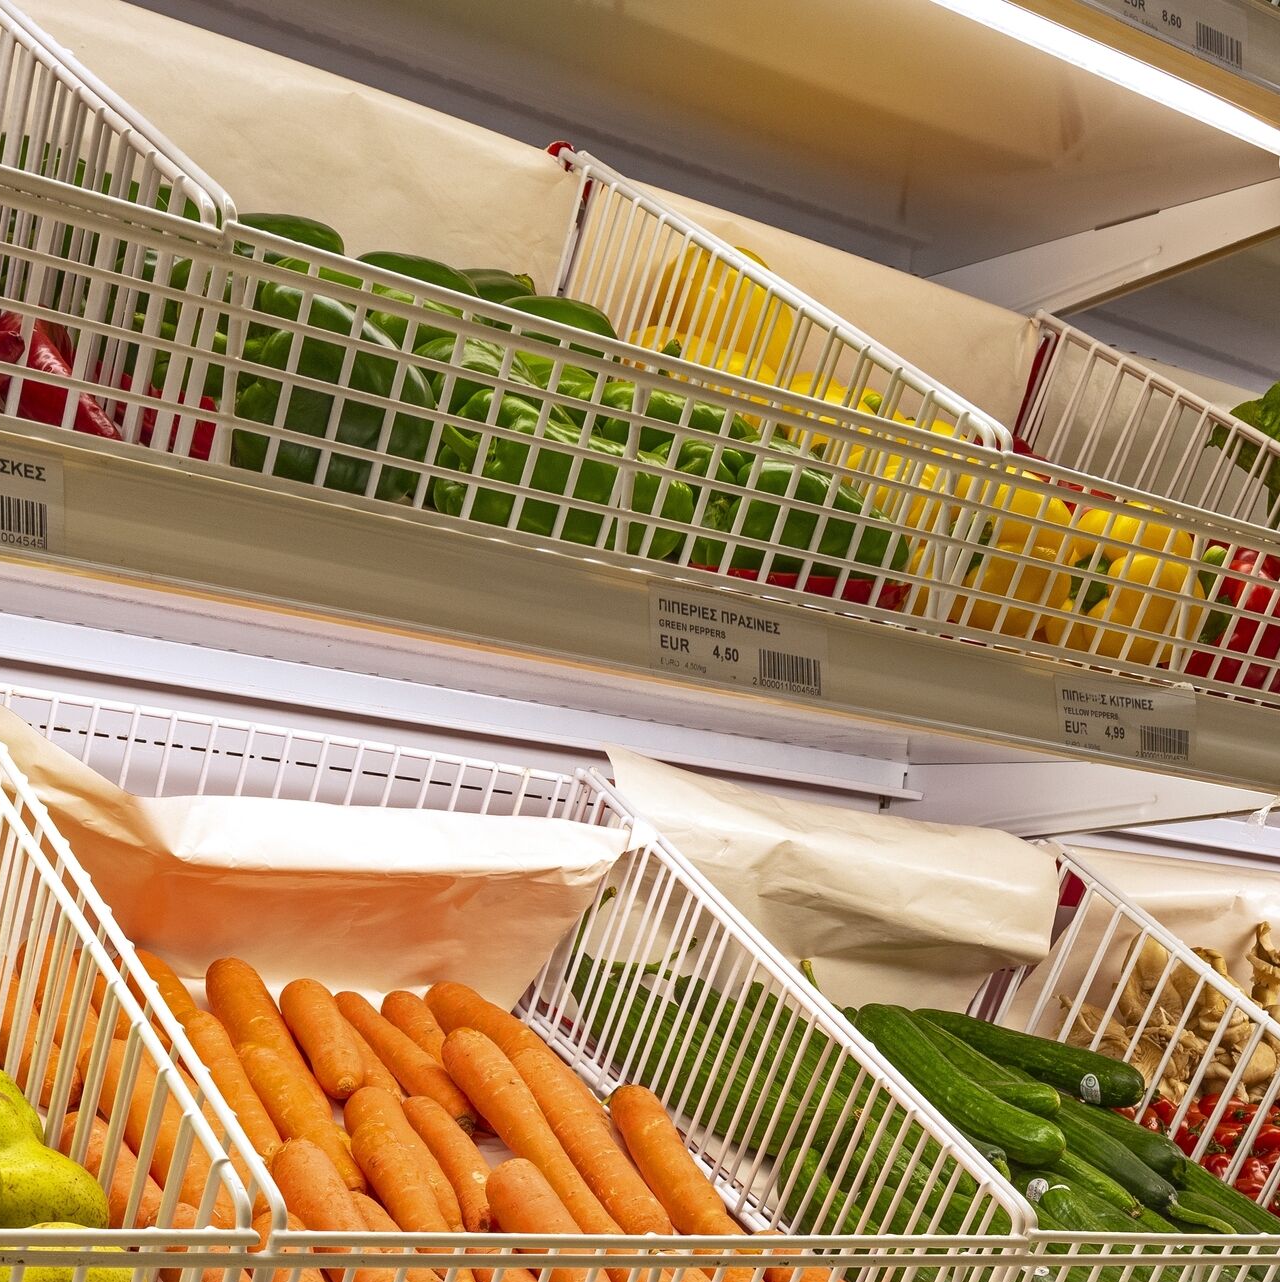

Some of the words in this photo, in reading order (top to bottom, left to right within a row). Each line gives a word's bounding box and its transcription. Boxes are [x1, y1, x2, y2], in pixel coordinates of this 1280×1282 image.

[1162, 10, 1182, 28] 8,60
[658, 598, 717, 622] ΠΙΠΕΡΙΕΣ
[721, 610, 781, 635] ΠΡΑΣΙΝΕΣ
[658, 618, 687, 632] GREEN
[689, 625, 726, 640] PEPPERS
[660, 634, 690, 653] EUR
[712, 645, 739, 663] 4,50
[1064, 706, 1090, 717] YELLOW
[1109, 695, 1154, 711] ΚΙΤΡΙΝΕΣ
[1065, 720, 1088, 736] EUR
[1105, 726, 1125, 739] 4,99
